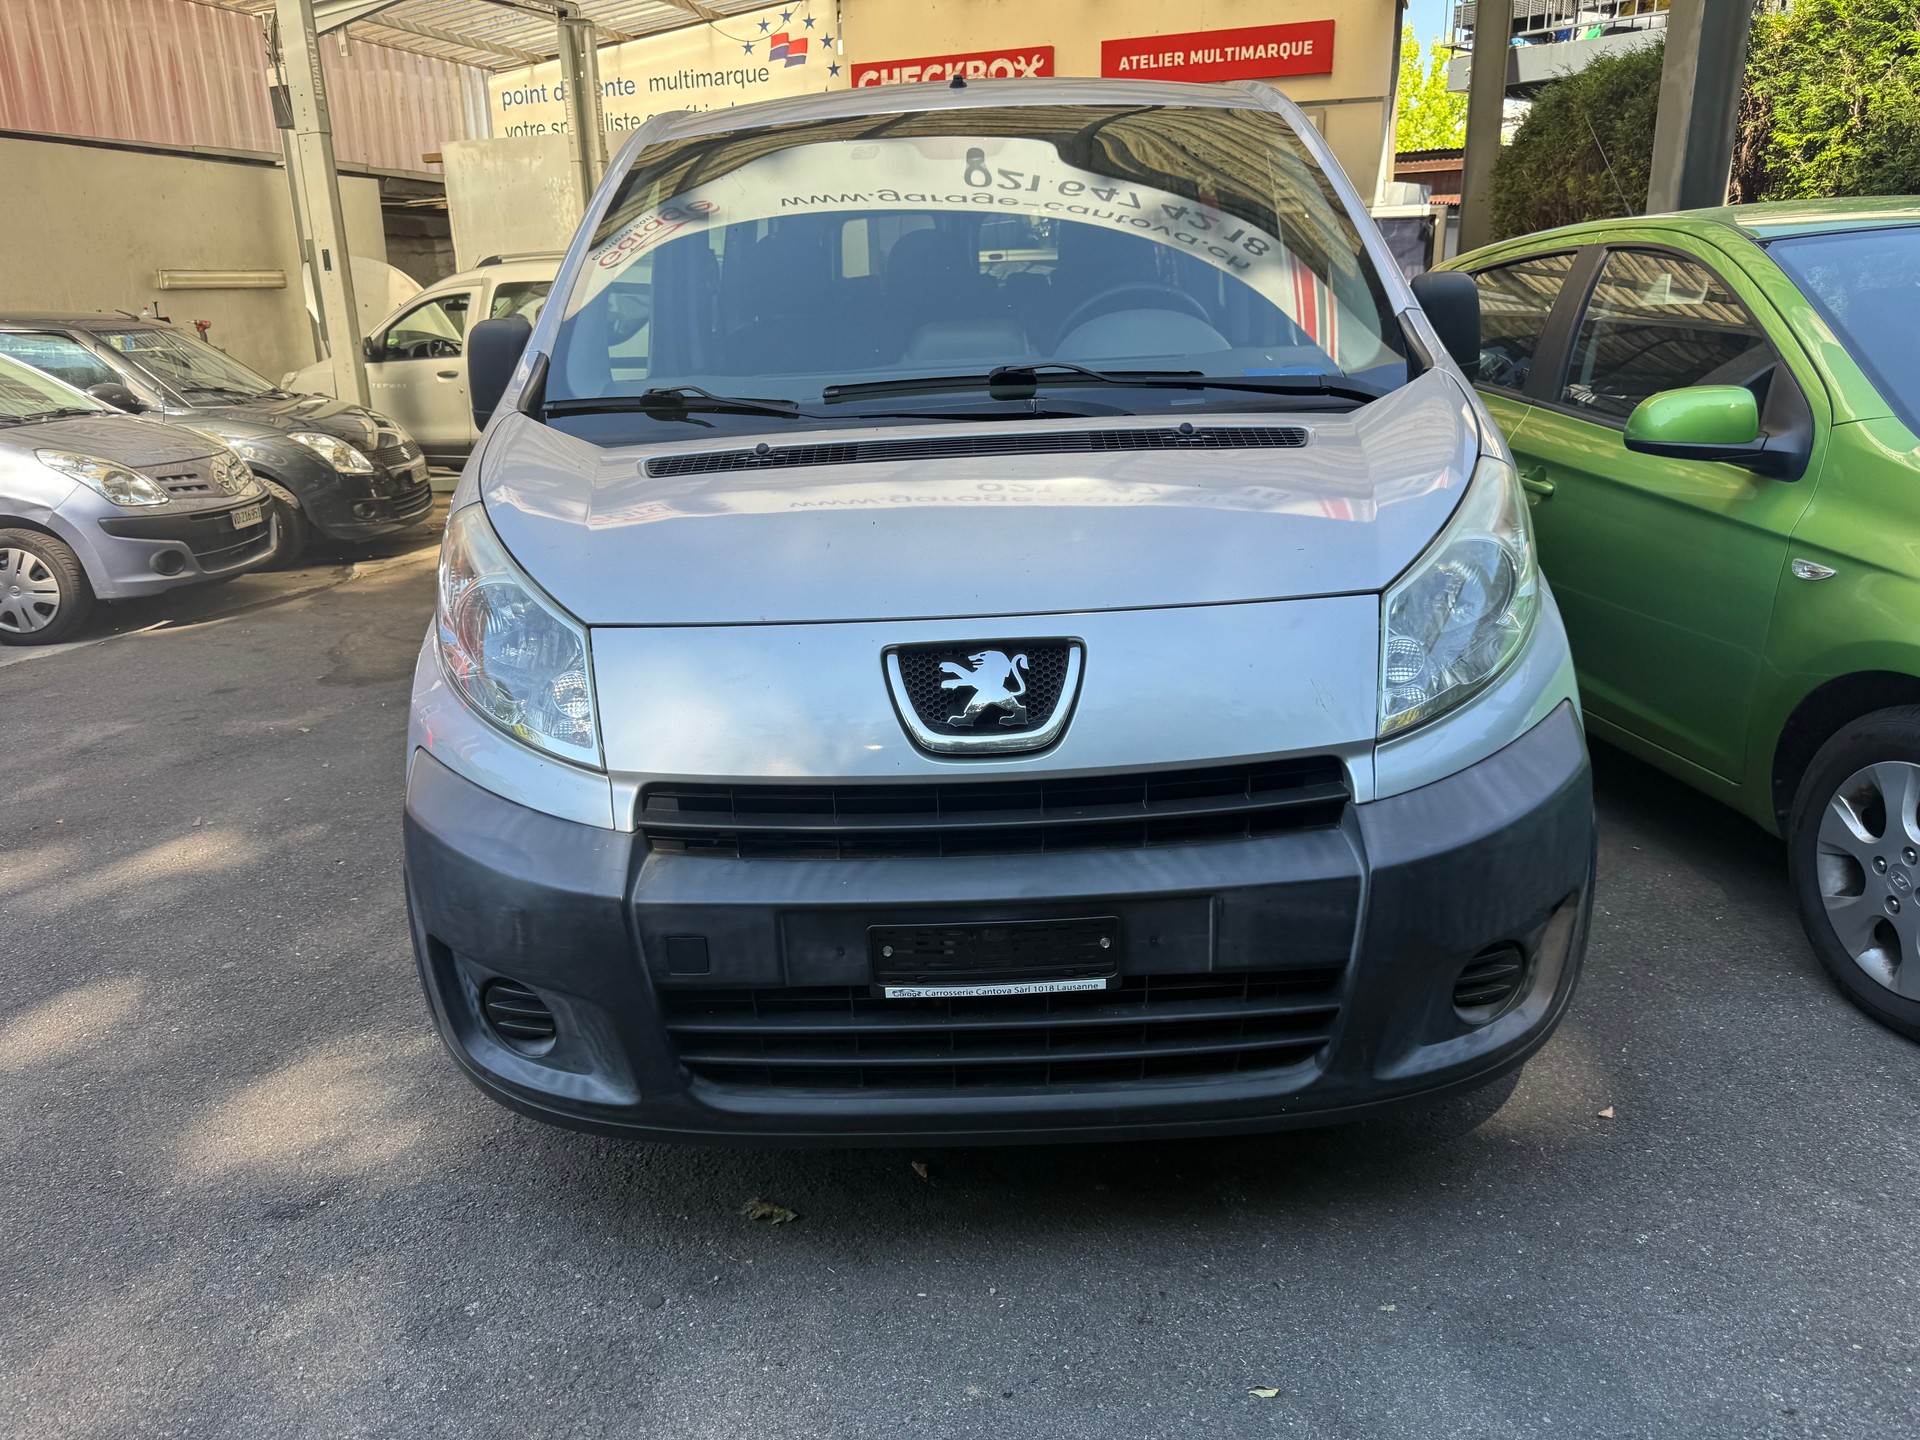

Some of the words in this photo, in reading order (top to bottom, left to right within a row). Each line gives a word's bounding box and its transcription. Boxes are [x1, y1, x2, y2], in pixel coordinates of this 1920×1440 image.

[306, 27, 316, 49] LIFT
[1118, 51, 1184, 71] ATELIER
[1189, 40, 1314, 65] MULTIMARQUE
[502, 84, 548, 111] point
[554, 81, 566, 101] d
[600, 77, 635, 97] nte
[649, 67, 769, 92] multimarque
[505, 121, 546, 138] votre
[370, 382, 408, 390] TEPWAY
[925, 989, 974, 997] Carrosserie
[976, 987, 1012, 996] Cantova
[1034, 984, 1055, 993] 1018
[1057, 983, 1099, 992] Lausanne
